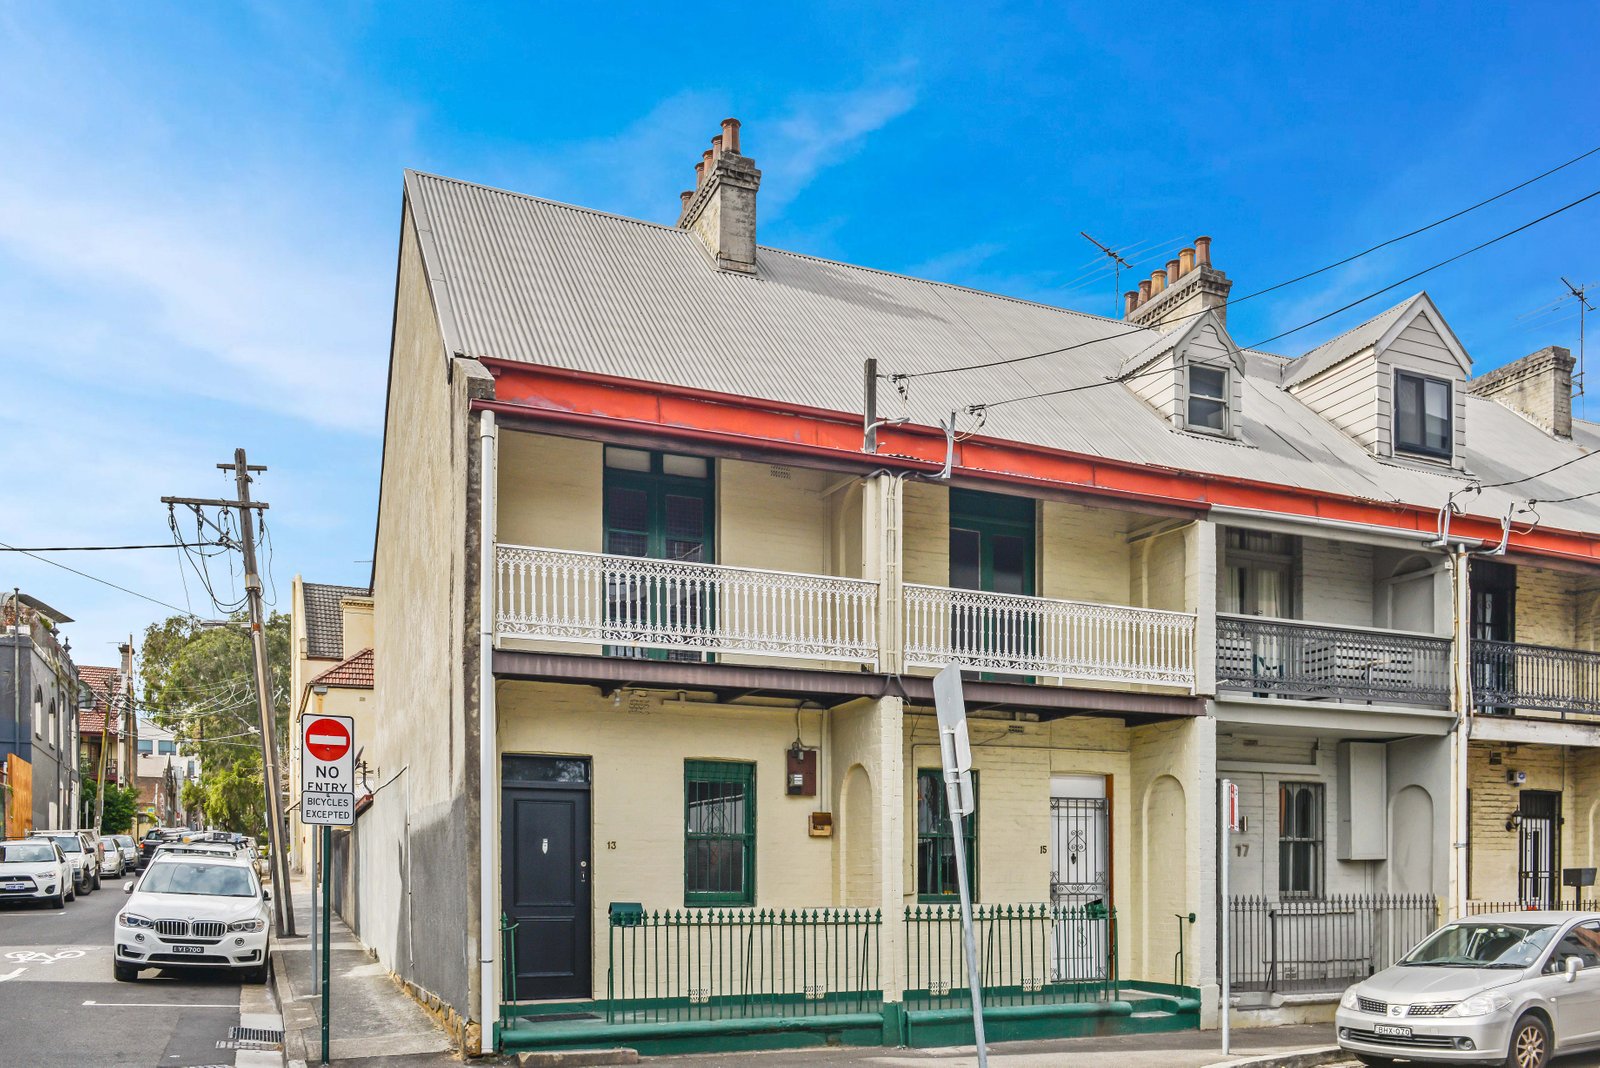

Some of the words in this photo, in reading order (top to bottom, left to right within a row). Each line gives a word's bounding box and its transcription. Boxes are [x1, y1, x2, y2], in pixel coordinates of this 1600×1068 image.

[316, 765, 339, 779] NO
[307, 781, 348, 792] ENTRY
[307, 797, 349, 807] BICYCLES
[306, 810, 350, 819] EXCEPTED
[607, 841, 617, 850] 13
[1040, 845, 1048, 855] 15
[1235, 843, 1249, 857] 17
